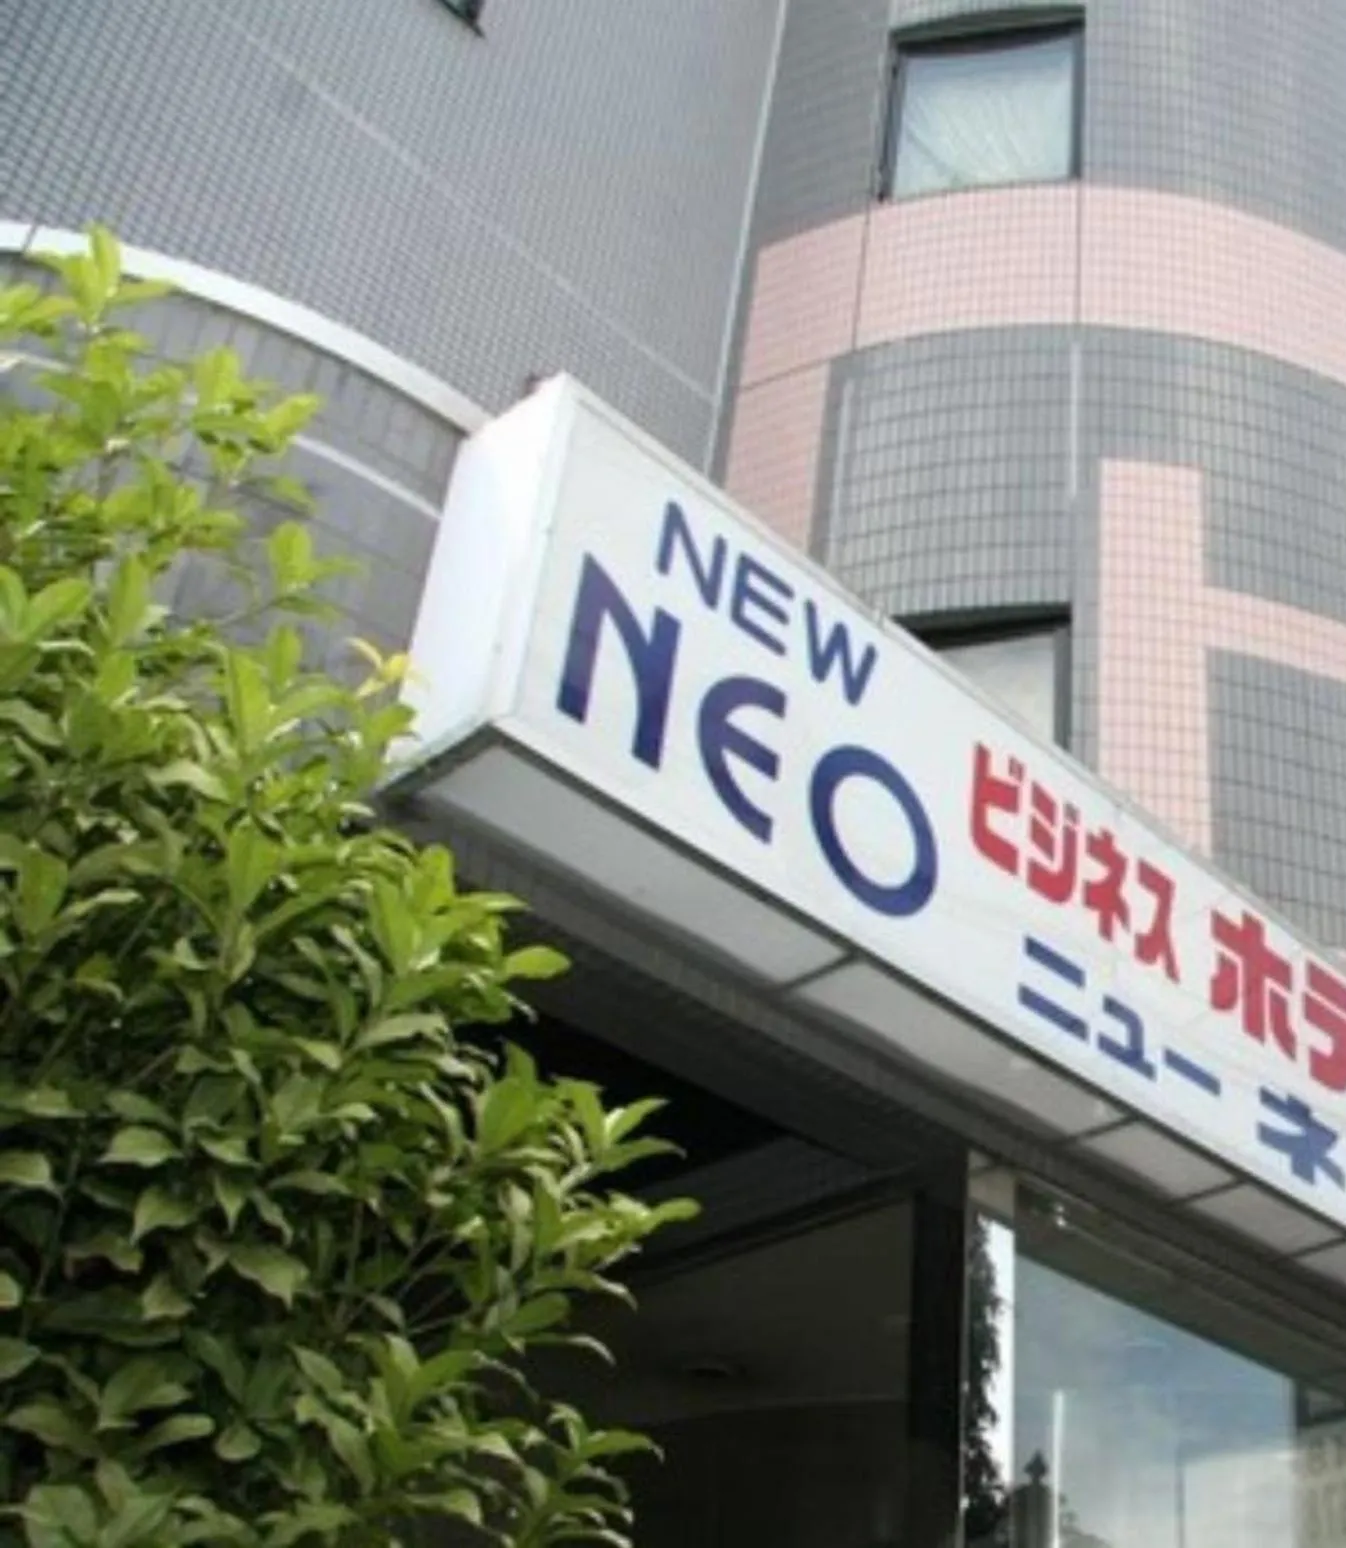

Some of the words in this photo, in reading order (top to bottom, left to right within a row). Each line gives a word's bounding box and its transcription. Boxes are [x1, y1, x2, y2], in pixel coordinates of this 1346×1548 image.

[656, 500, 878, 706] NEW
[555, 551, 939, 918] NEO
[969, 741, 1180, 983] ビジネス
[1017, 934, 1221, 1096] ニュー
